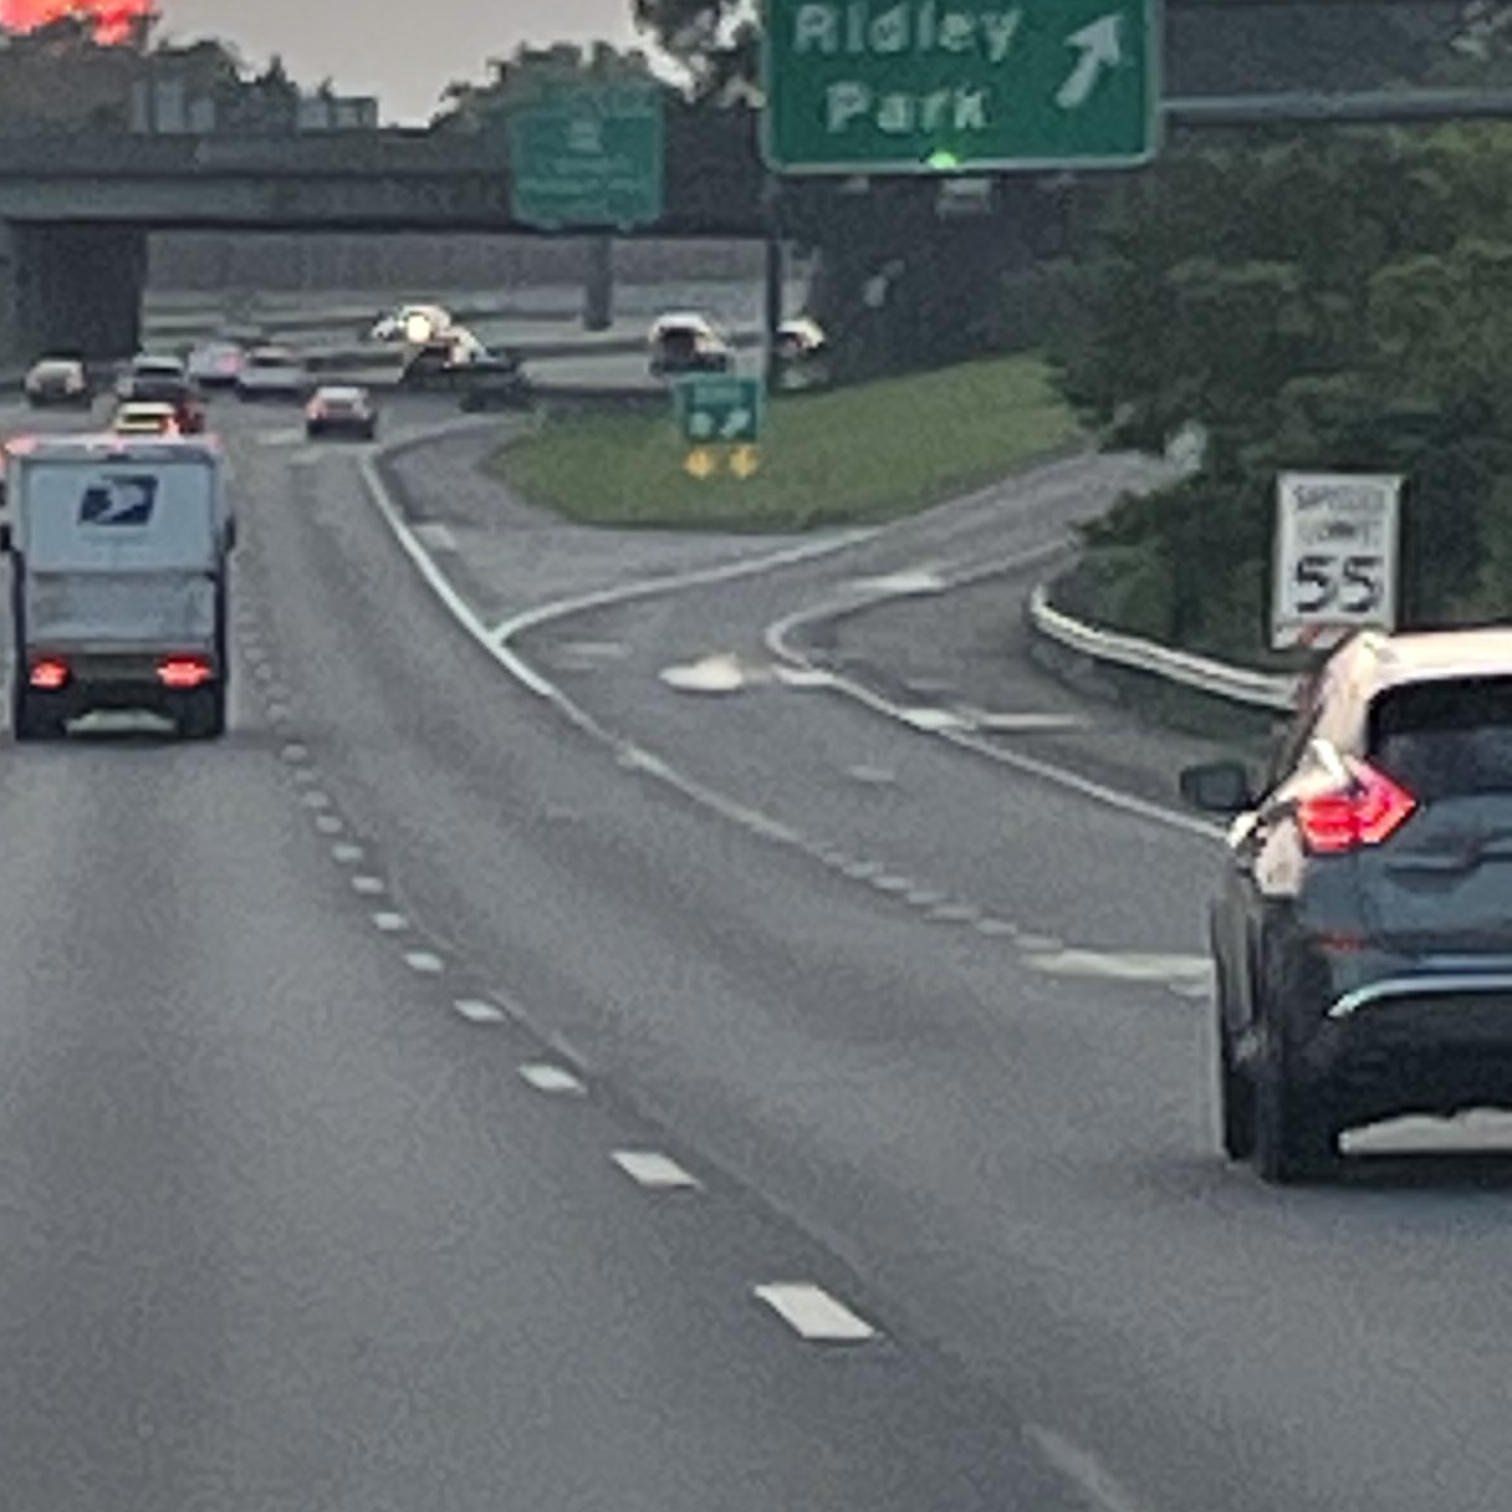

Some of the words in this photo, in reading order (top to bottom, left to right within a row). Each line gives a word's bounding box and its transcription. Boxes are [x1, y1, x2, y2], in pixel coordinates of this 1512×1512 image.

[793, 0, 1021, 62] Ridley
[825, 82, 988, 133] Park
[1294, 555, 1386, 614] 55
